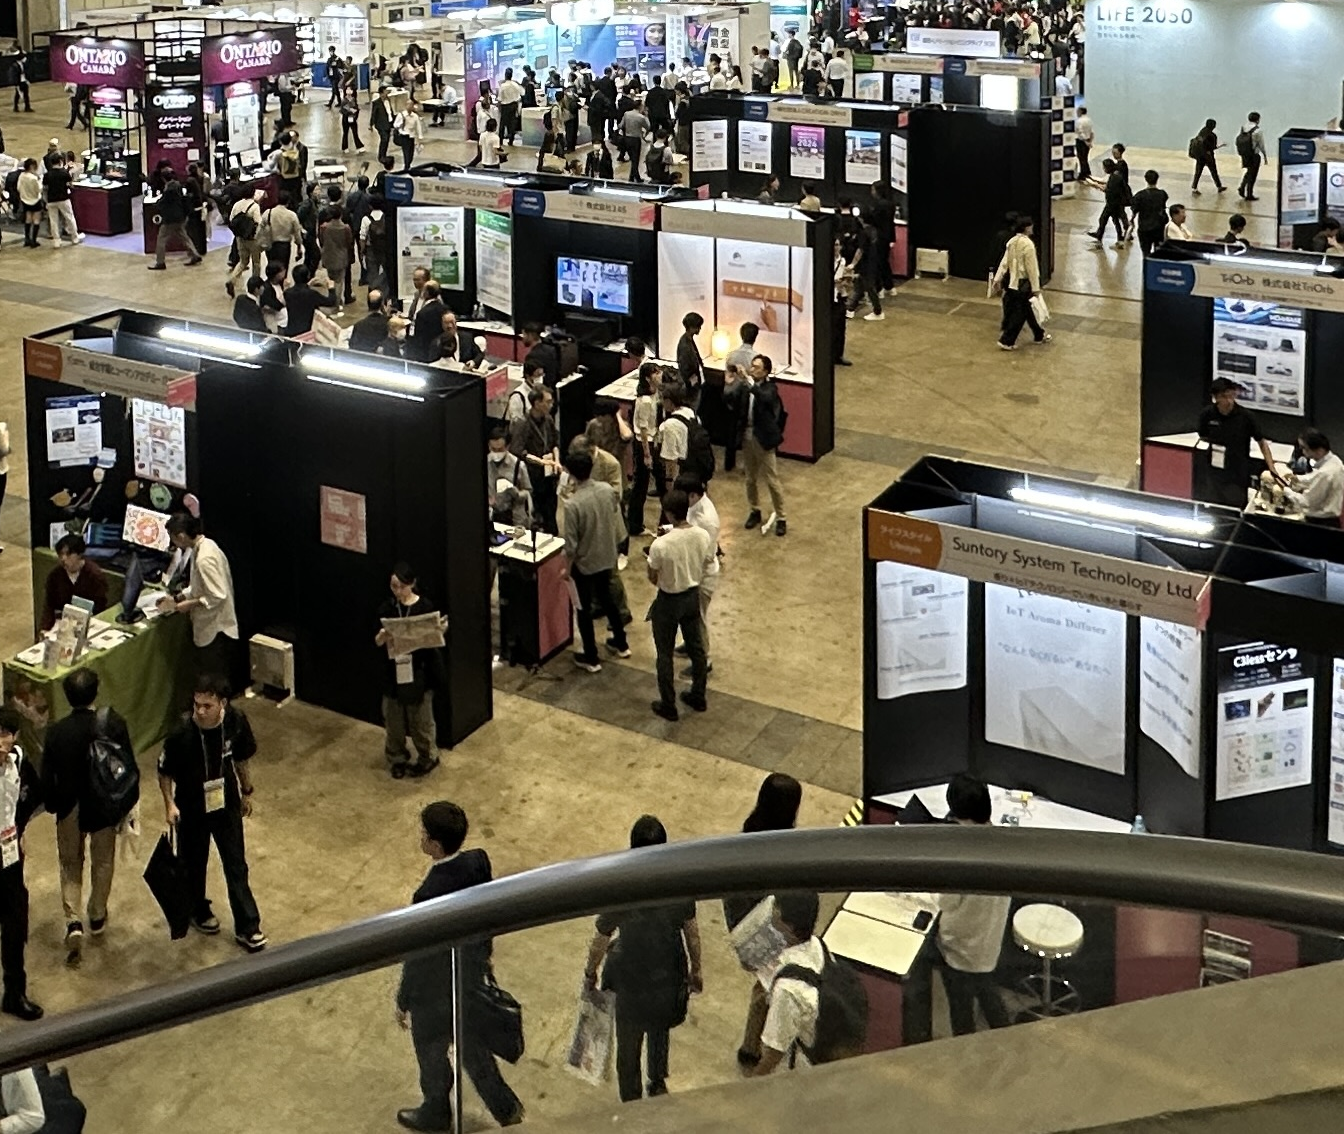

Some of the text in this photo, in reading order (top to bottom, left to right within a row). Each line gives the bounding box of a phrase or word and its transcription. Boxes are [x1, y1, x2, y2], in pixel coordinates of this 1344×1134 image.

[1141, 5, 1194, 24] 2050
[66, 45, 127, 66] ONTARIO
[220, 39, 281, 64] ONTARIO
[80, 63, 116, 75] CANADA
[236, 57, 272, 70] CANADA
[1220, 273, 1335, 295] TriOrb 株式会社TriOrb
[952, 536, 1198, 602] Suntory System Technology Ltd.
[1006, 604, 1108, 636] IoT Aroma Diffuser
